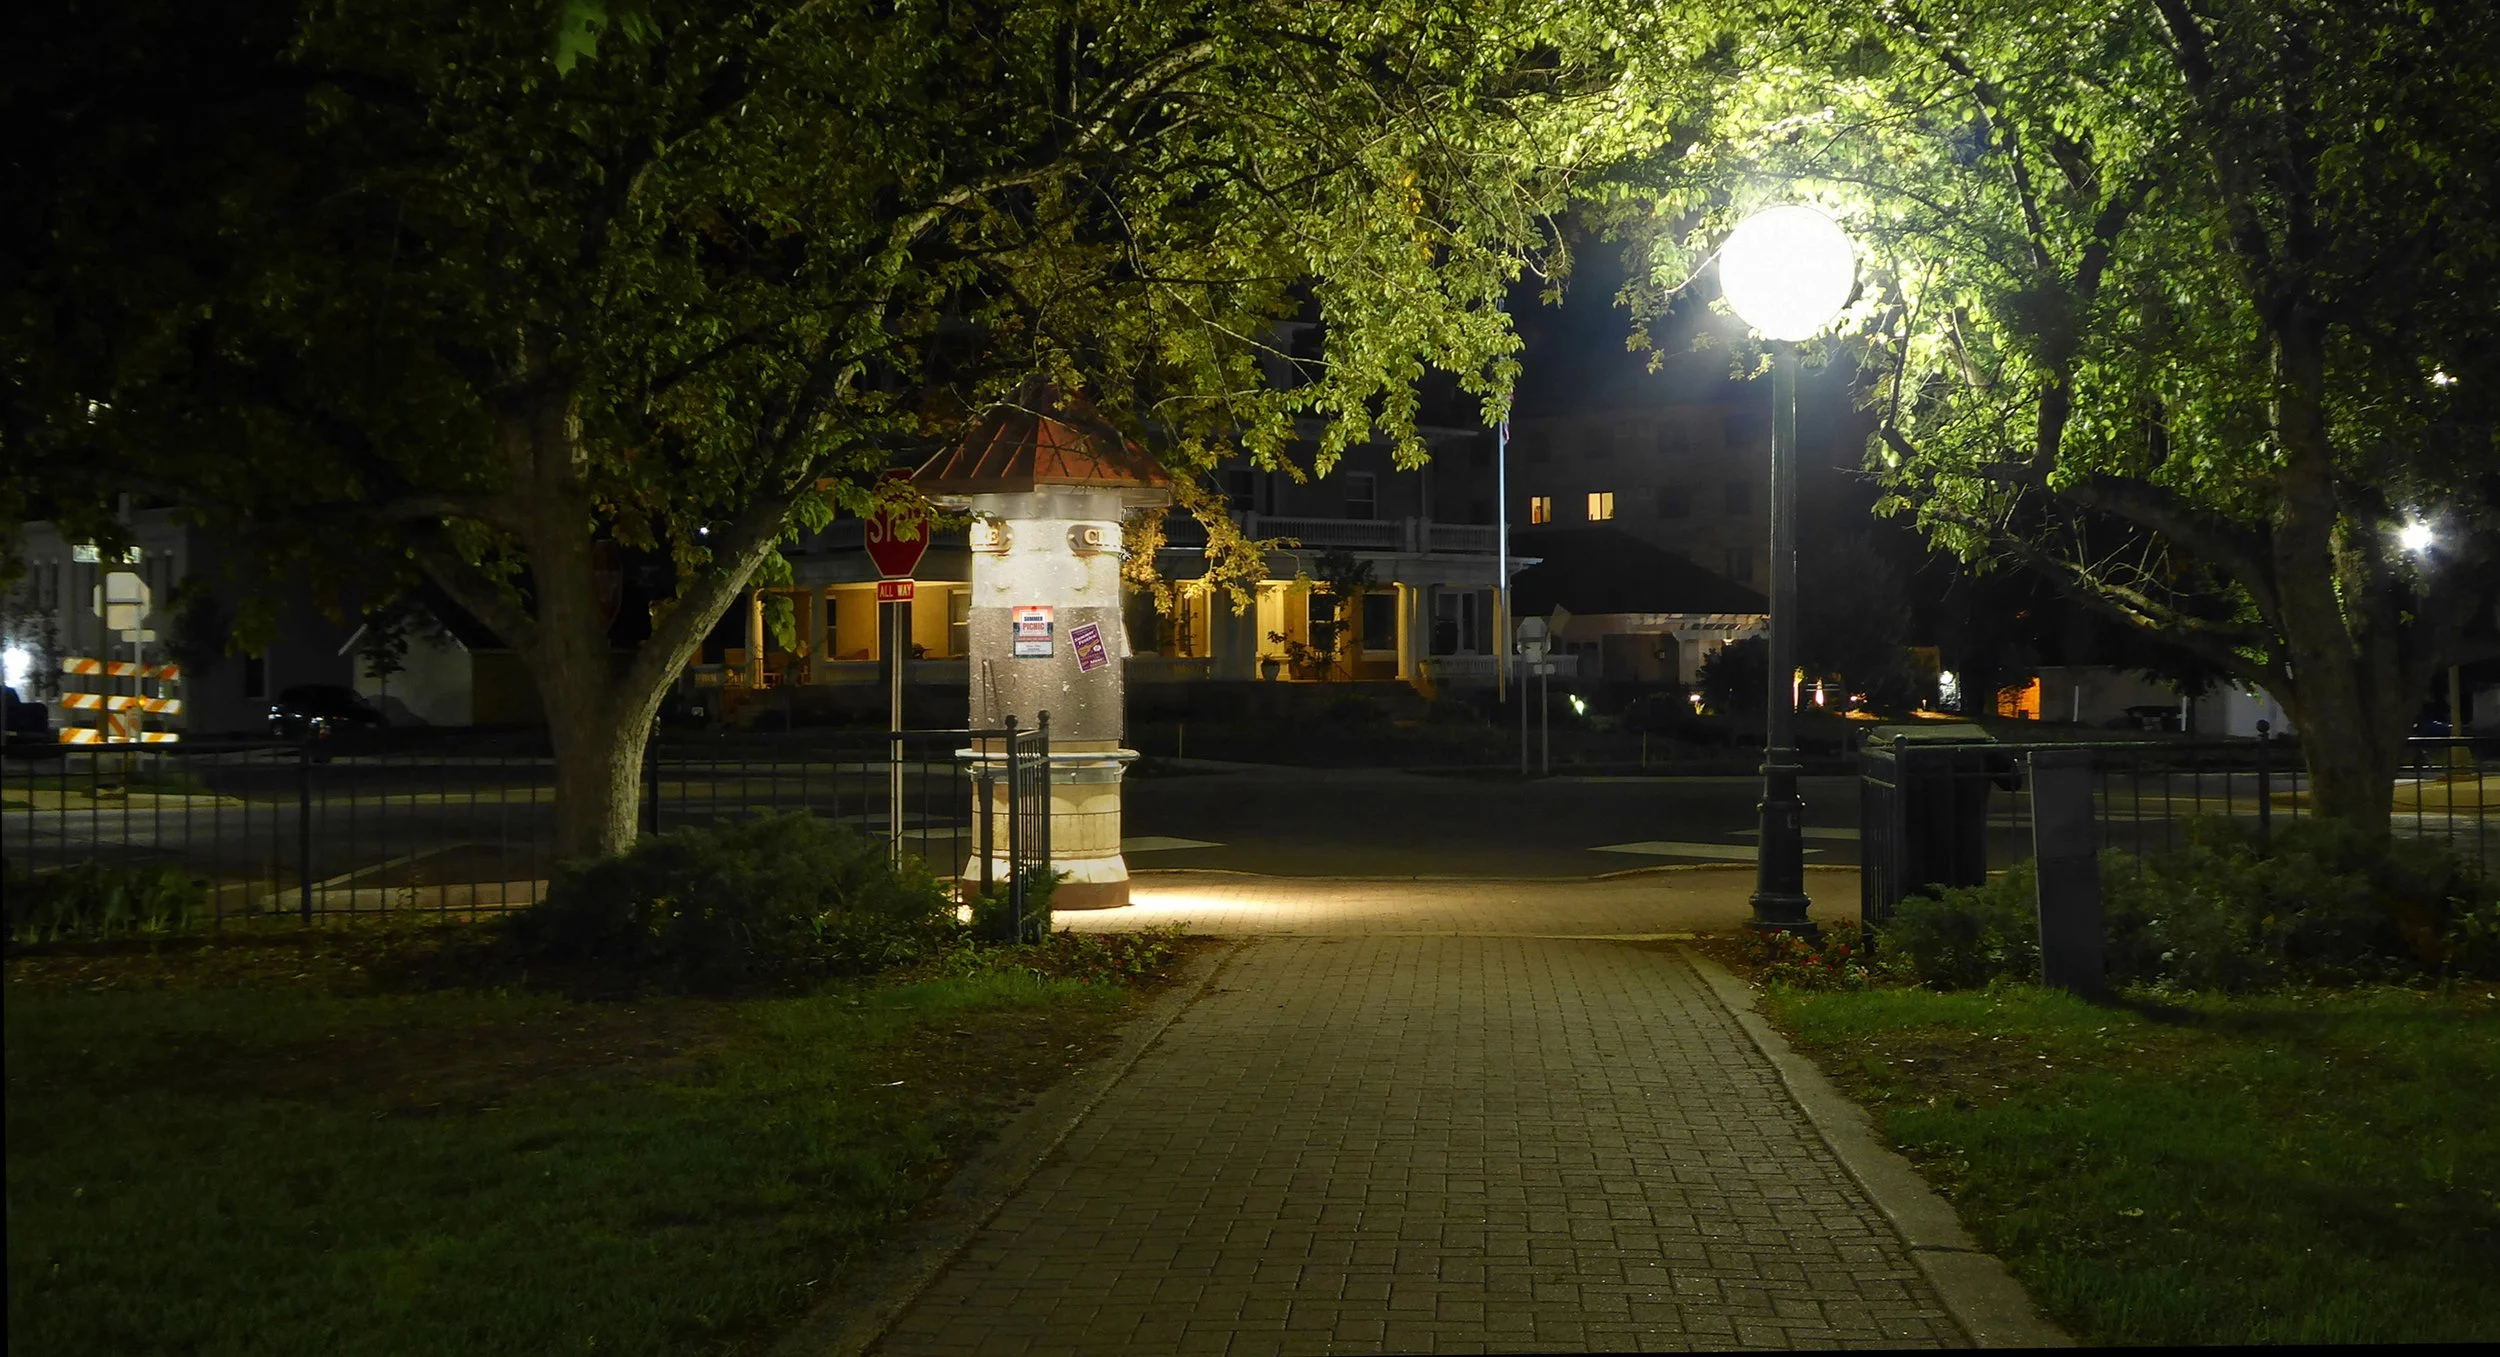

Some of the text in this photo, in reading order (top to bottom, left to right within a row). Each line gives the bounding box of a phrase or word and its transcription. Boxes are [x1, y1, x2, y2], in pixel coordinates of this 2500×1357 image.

[880, 584, 912, 597] ALL WAY
[1023, 622, 1044, 630] PICNIC
